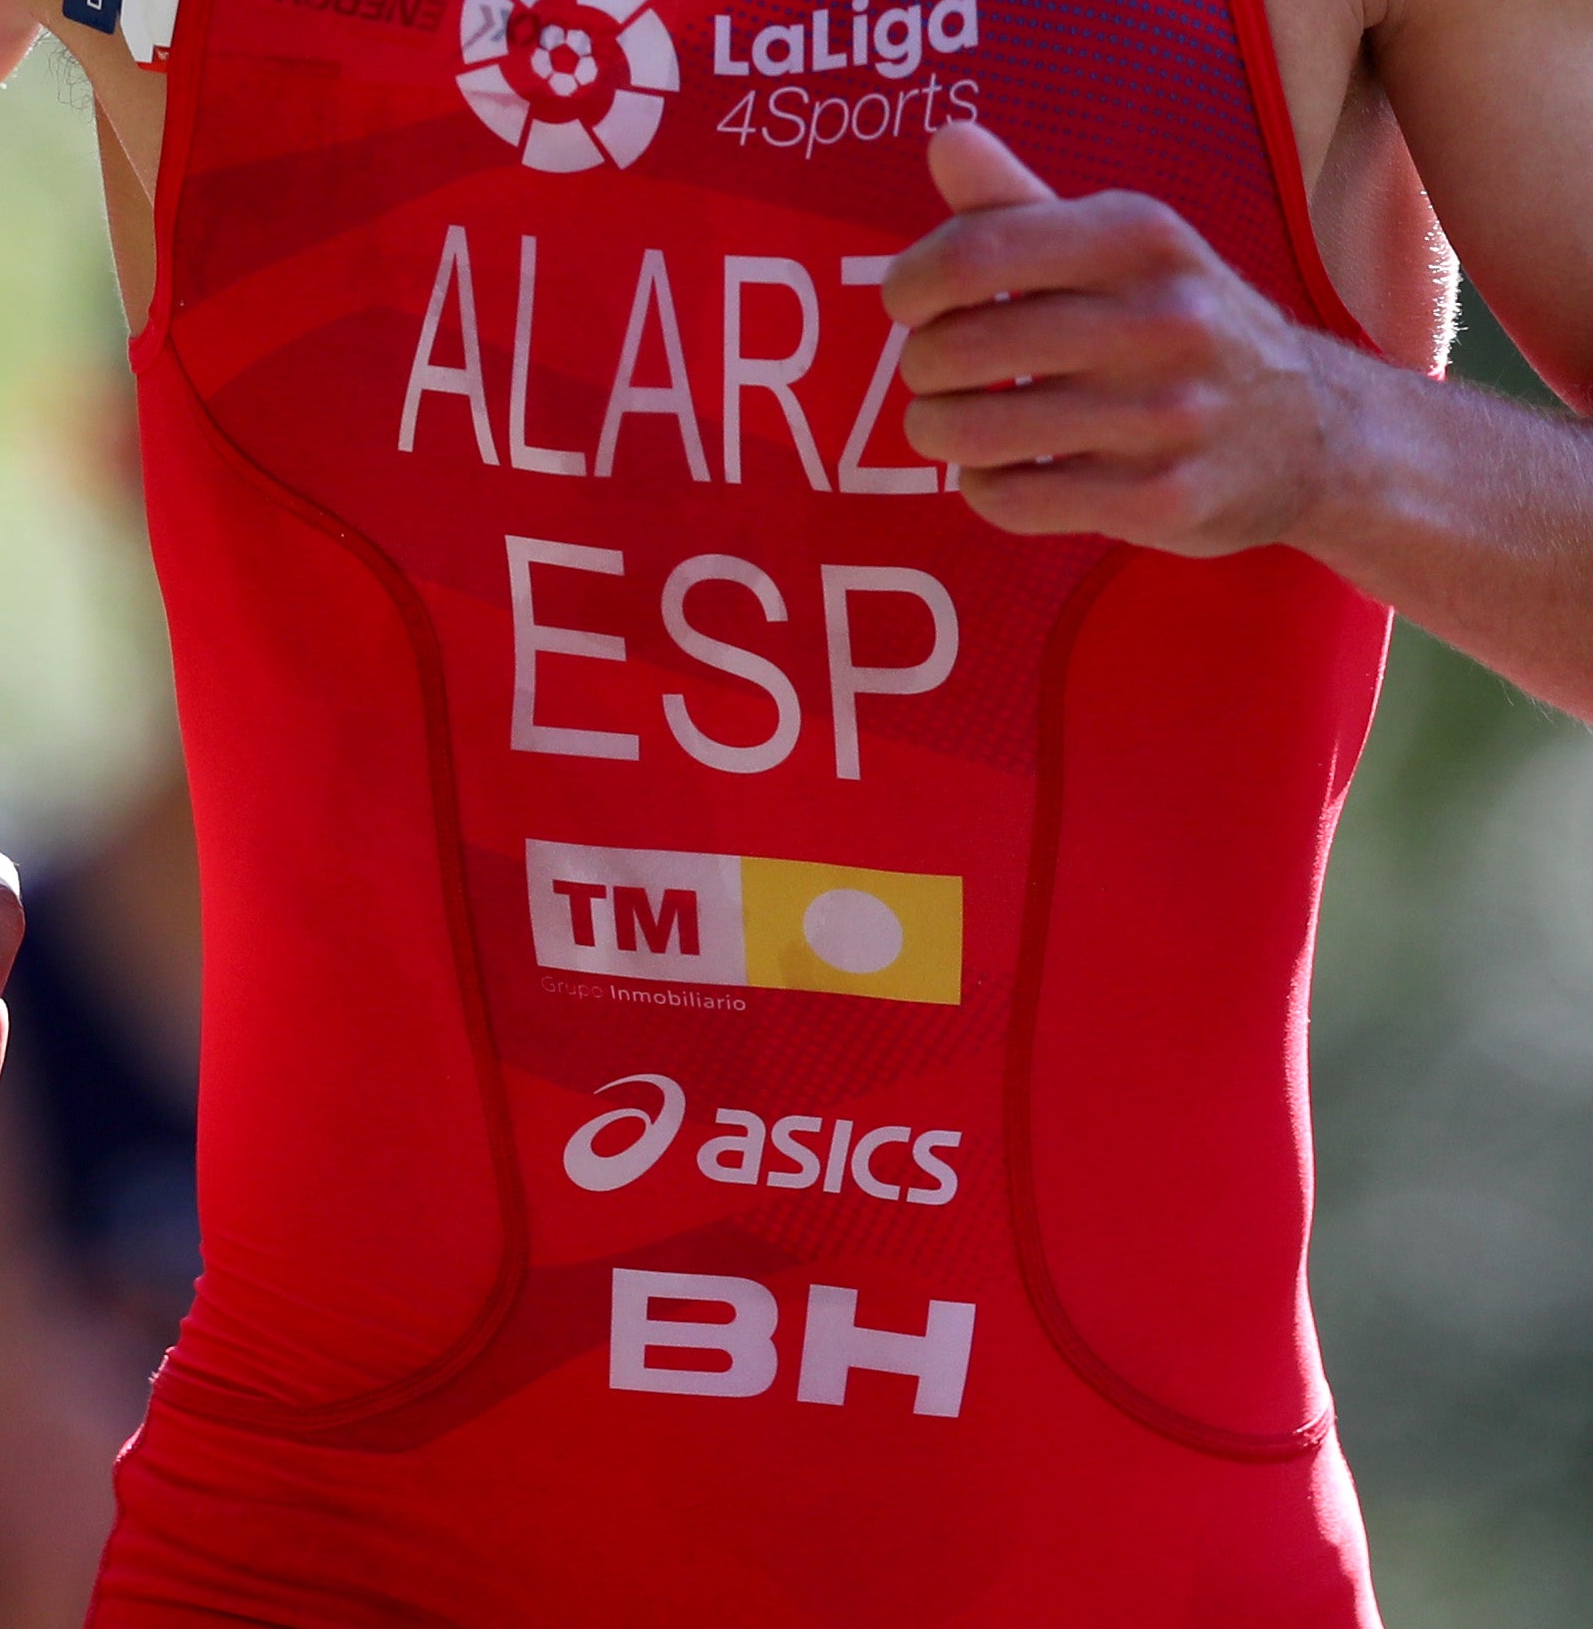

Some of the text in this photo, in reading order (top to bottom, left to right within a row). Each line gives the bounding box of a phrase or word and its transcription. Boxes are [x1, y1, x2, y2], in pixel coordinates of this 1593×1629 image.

[716, 72, 980, 160] 4Sports
[397, 224, 1053, 496] ALARZ
[504, 534, 960, 781] ESP
[552, 878, 701, 957] TM
[540, 976, 747, 1012] Grupo Inmobiliario
[696, 1107, 963, 1207] asics
[609, 1267, 976, 1419] BH
